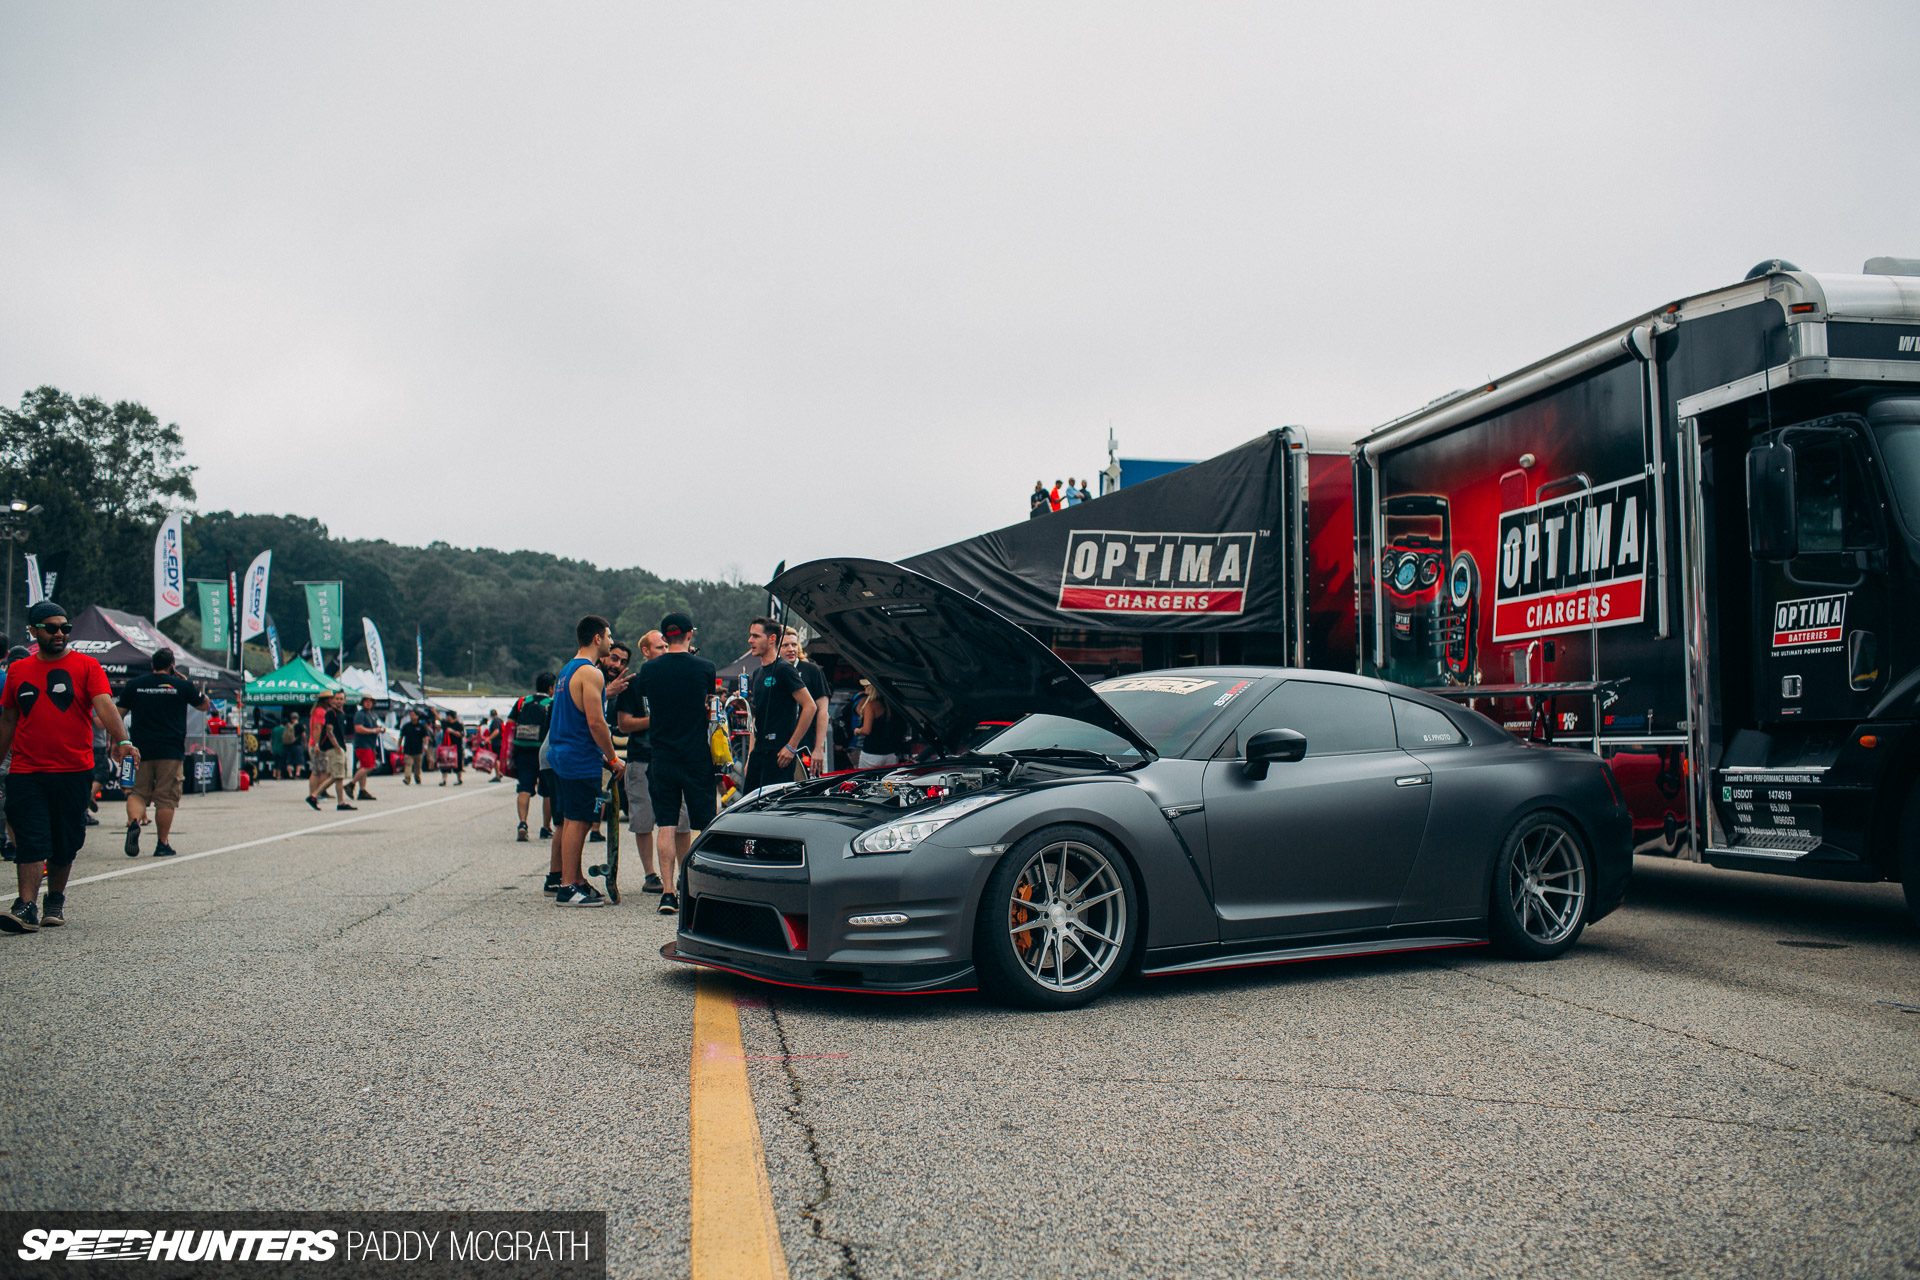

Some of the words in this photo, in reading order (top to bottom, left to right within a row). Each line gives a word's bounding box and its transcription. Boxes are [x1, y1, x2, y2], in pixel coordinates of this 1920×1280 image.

[1502, 495, 1639, 589] OPTIMA
[167, 528, 180, 591] EXEDY
[1072, 540, 1241, 583] OPTIMA
[254, 565, 265, 619] EXEDY
[1105, 593, 1210, 610] CHARGERS
[210, 589, 221, 643] TAKATA
[317, 590, 332, 641] TAKATA
[1526, 593, 1611, 628] CHARGERS
[1777, 600, 1841, 629] OPTIMA
[66, 640, 122, 654] XEDY
[1788, 630, 1828, 643] BATTERIES
[1781, 648, 1803, 656] ULTIMATE
[1804, 647, 1821, 655] POWER
[256, 679, 320, 690] TAKATA
[121, 760, 131, 781] NOS
[1733, 789, 1753, 799] USDOT
[1768, 790, 1792, 800] 1474519
